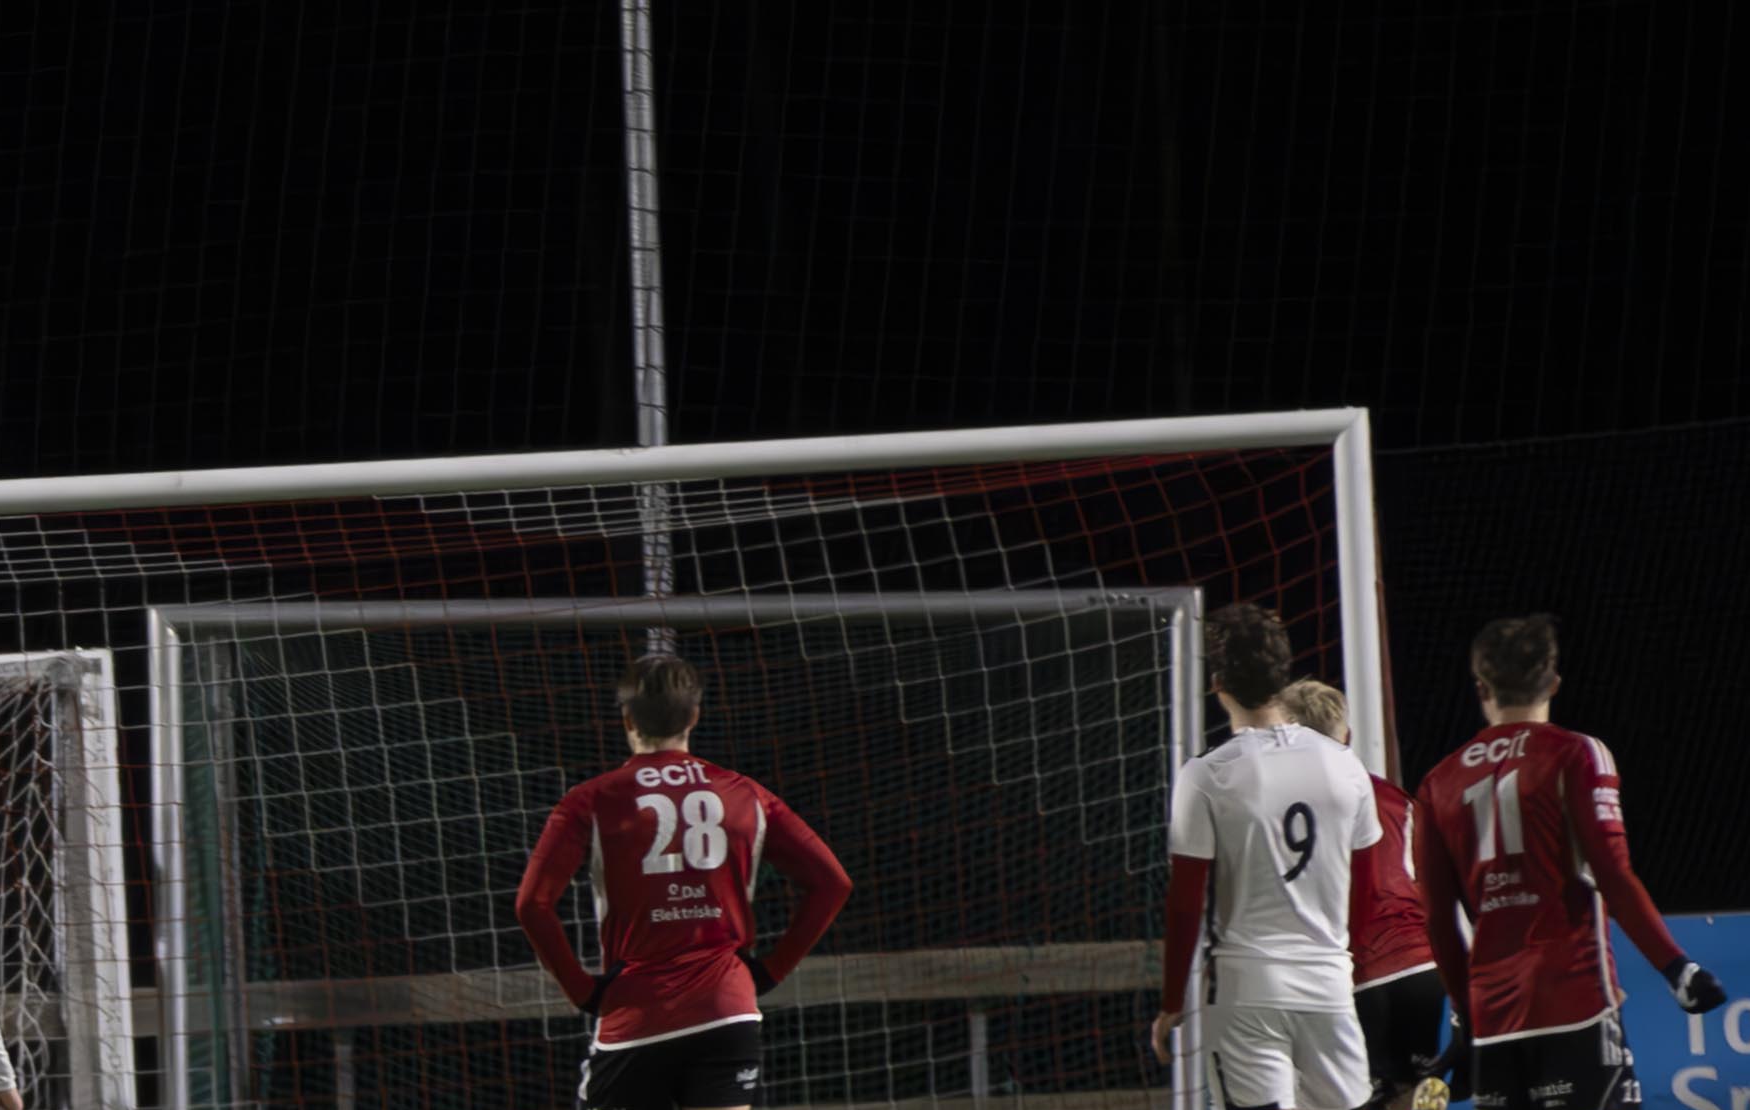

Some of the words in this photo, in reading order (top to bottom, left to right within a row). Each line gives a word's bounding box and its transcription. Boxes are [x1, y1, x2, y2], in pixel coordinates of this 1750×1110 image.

[635, 760, 712, 787] ecit
[1461, 729, 1530, 767] ecit
[635, 790, 728, 875] 28
[1282, 802, 1316, 882] 9
[1463, 769, 1524, 863] 11
[1622, 1079, 1642, 1103] 11
